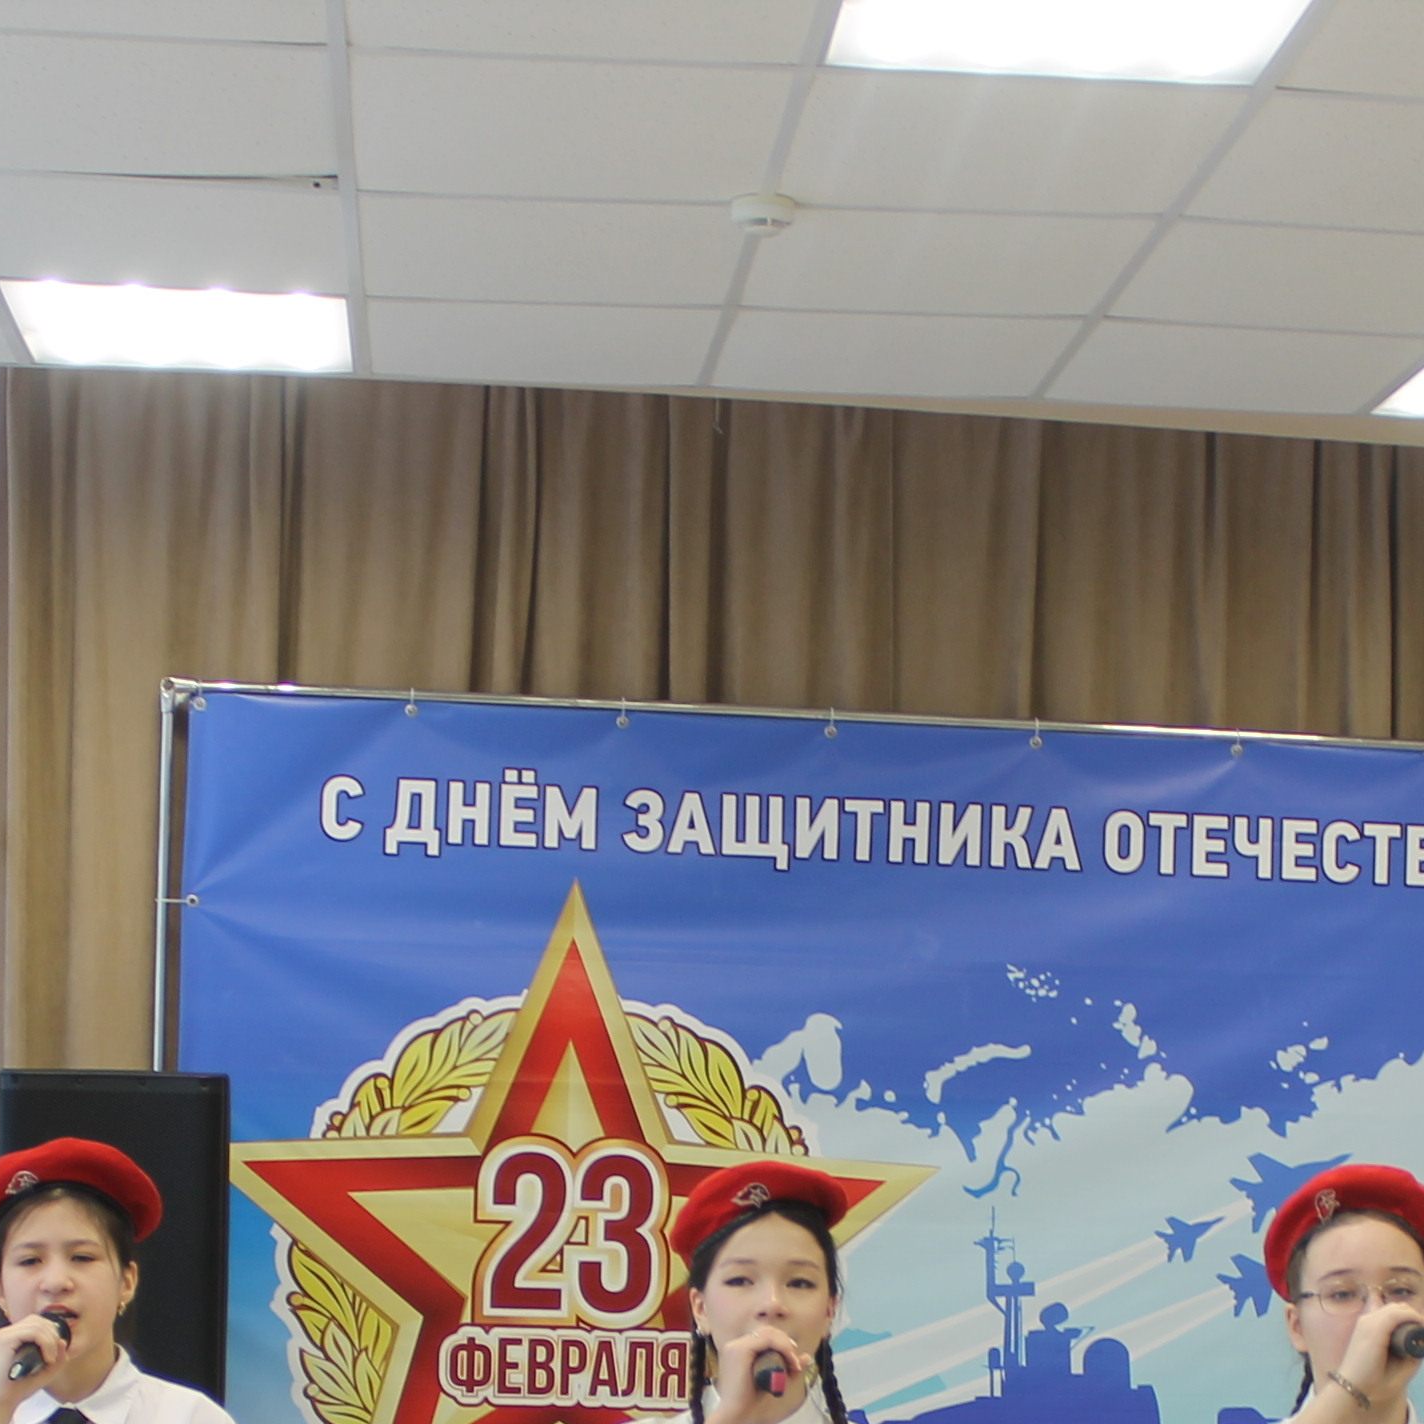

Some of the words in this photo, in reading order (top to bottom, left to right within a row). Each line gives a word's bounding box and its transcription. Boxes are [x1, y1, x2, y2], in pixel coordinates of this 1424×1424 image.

[320, 775, 366, 842] С
[382, 767, 599, 858] ДНЁМ
[621, 787, 1084, 872] ЗАЩИТНИКА
[486, 1147, 658, 1318] 23
[448, 1335, 689, 1401] ФЕВРАЛЯ
